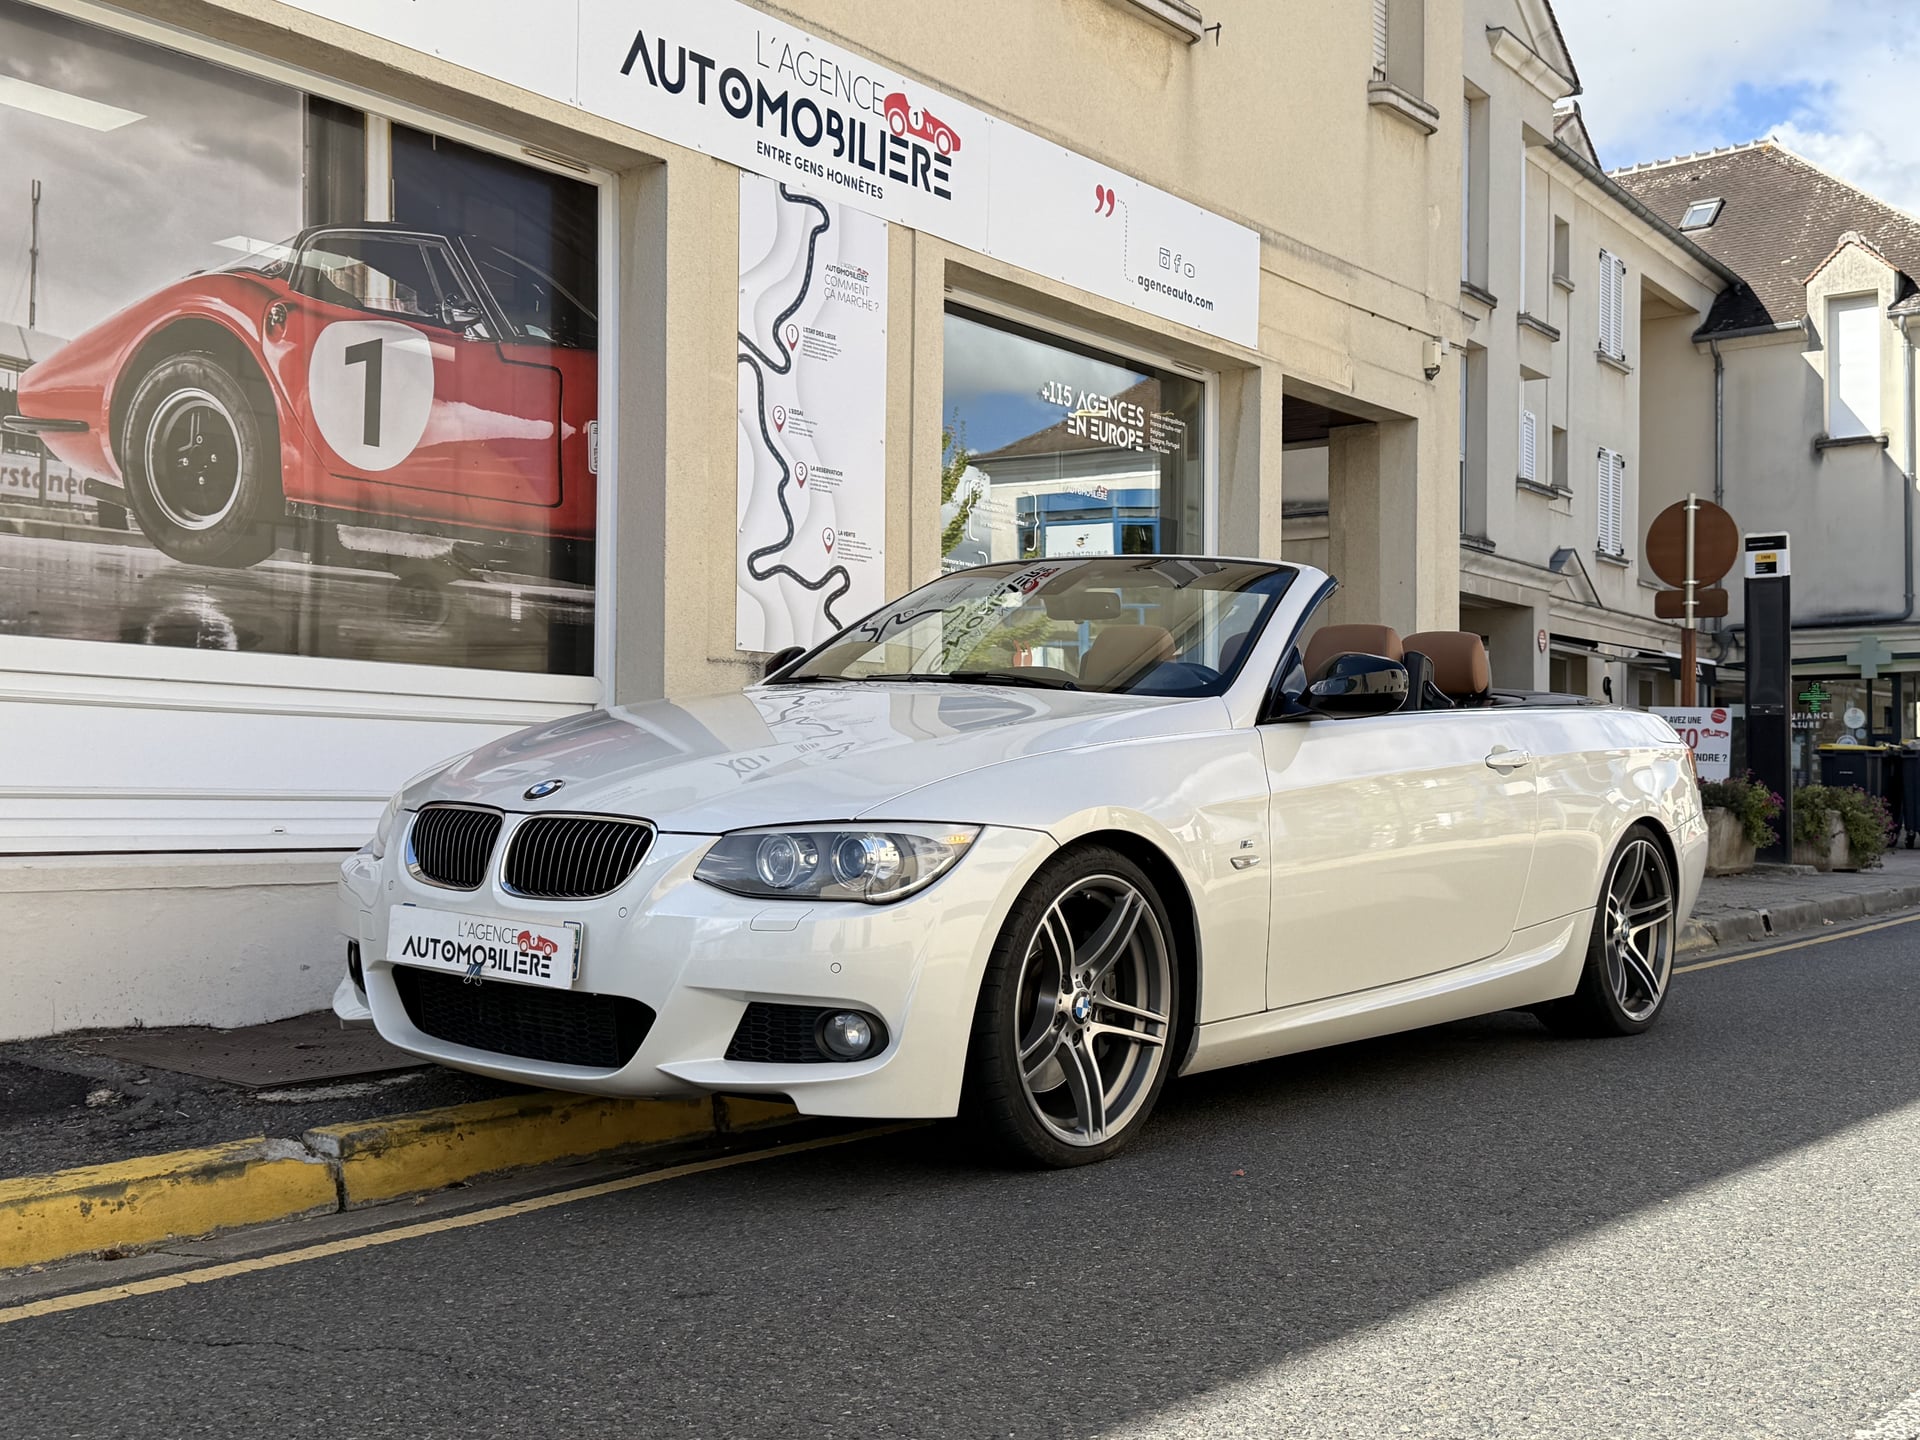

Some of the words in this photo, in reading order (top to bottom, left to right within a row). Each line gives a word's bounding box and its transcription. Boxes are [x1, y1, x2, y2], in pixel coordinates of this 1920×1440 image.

[756, 30, 885, 117] L'AGENCE
[913, 111, 919, 126] 1
[756, 140, 792, 166] ENTRE
[794, 156, 824, 178] GENS
[827, 168, 883, 199] HONNÊTES
[824, 273, 869, 297] COMMENT
[1138, 274, 1214, 311] agenceauto.com
[824, 287, 836, 301] ÇA
[837, 290, 873, 311] MARCHE
[874, 302, 880, 312] ?
[344, 338, 383, 447] 1
[1041, 381, 1073, 407] +115
[1076, 390, 1144, 428] AGENCES
[777, 410, 783, 420] 2
[1067, 411, 1087, 438] EN
[1090, 418, 1144, 453] EUROPE
[798, 466, 804, 476] 3
[826, 532, 831, 542] 4
[1669, 716, 1686, 724] AVEZ
[1688, 716, 1702, 724] UNE
[458, 920, 518, 945] L'AGENCE
